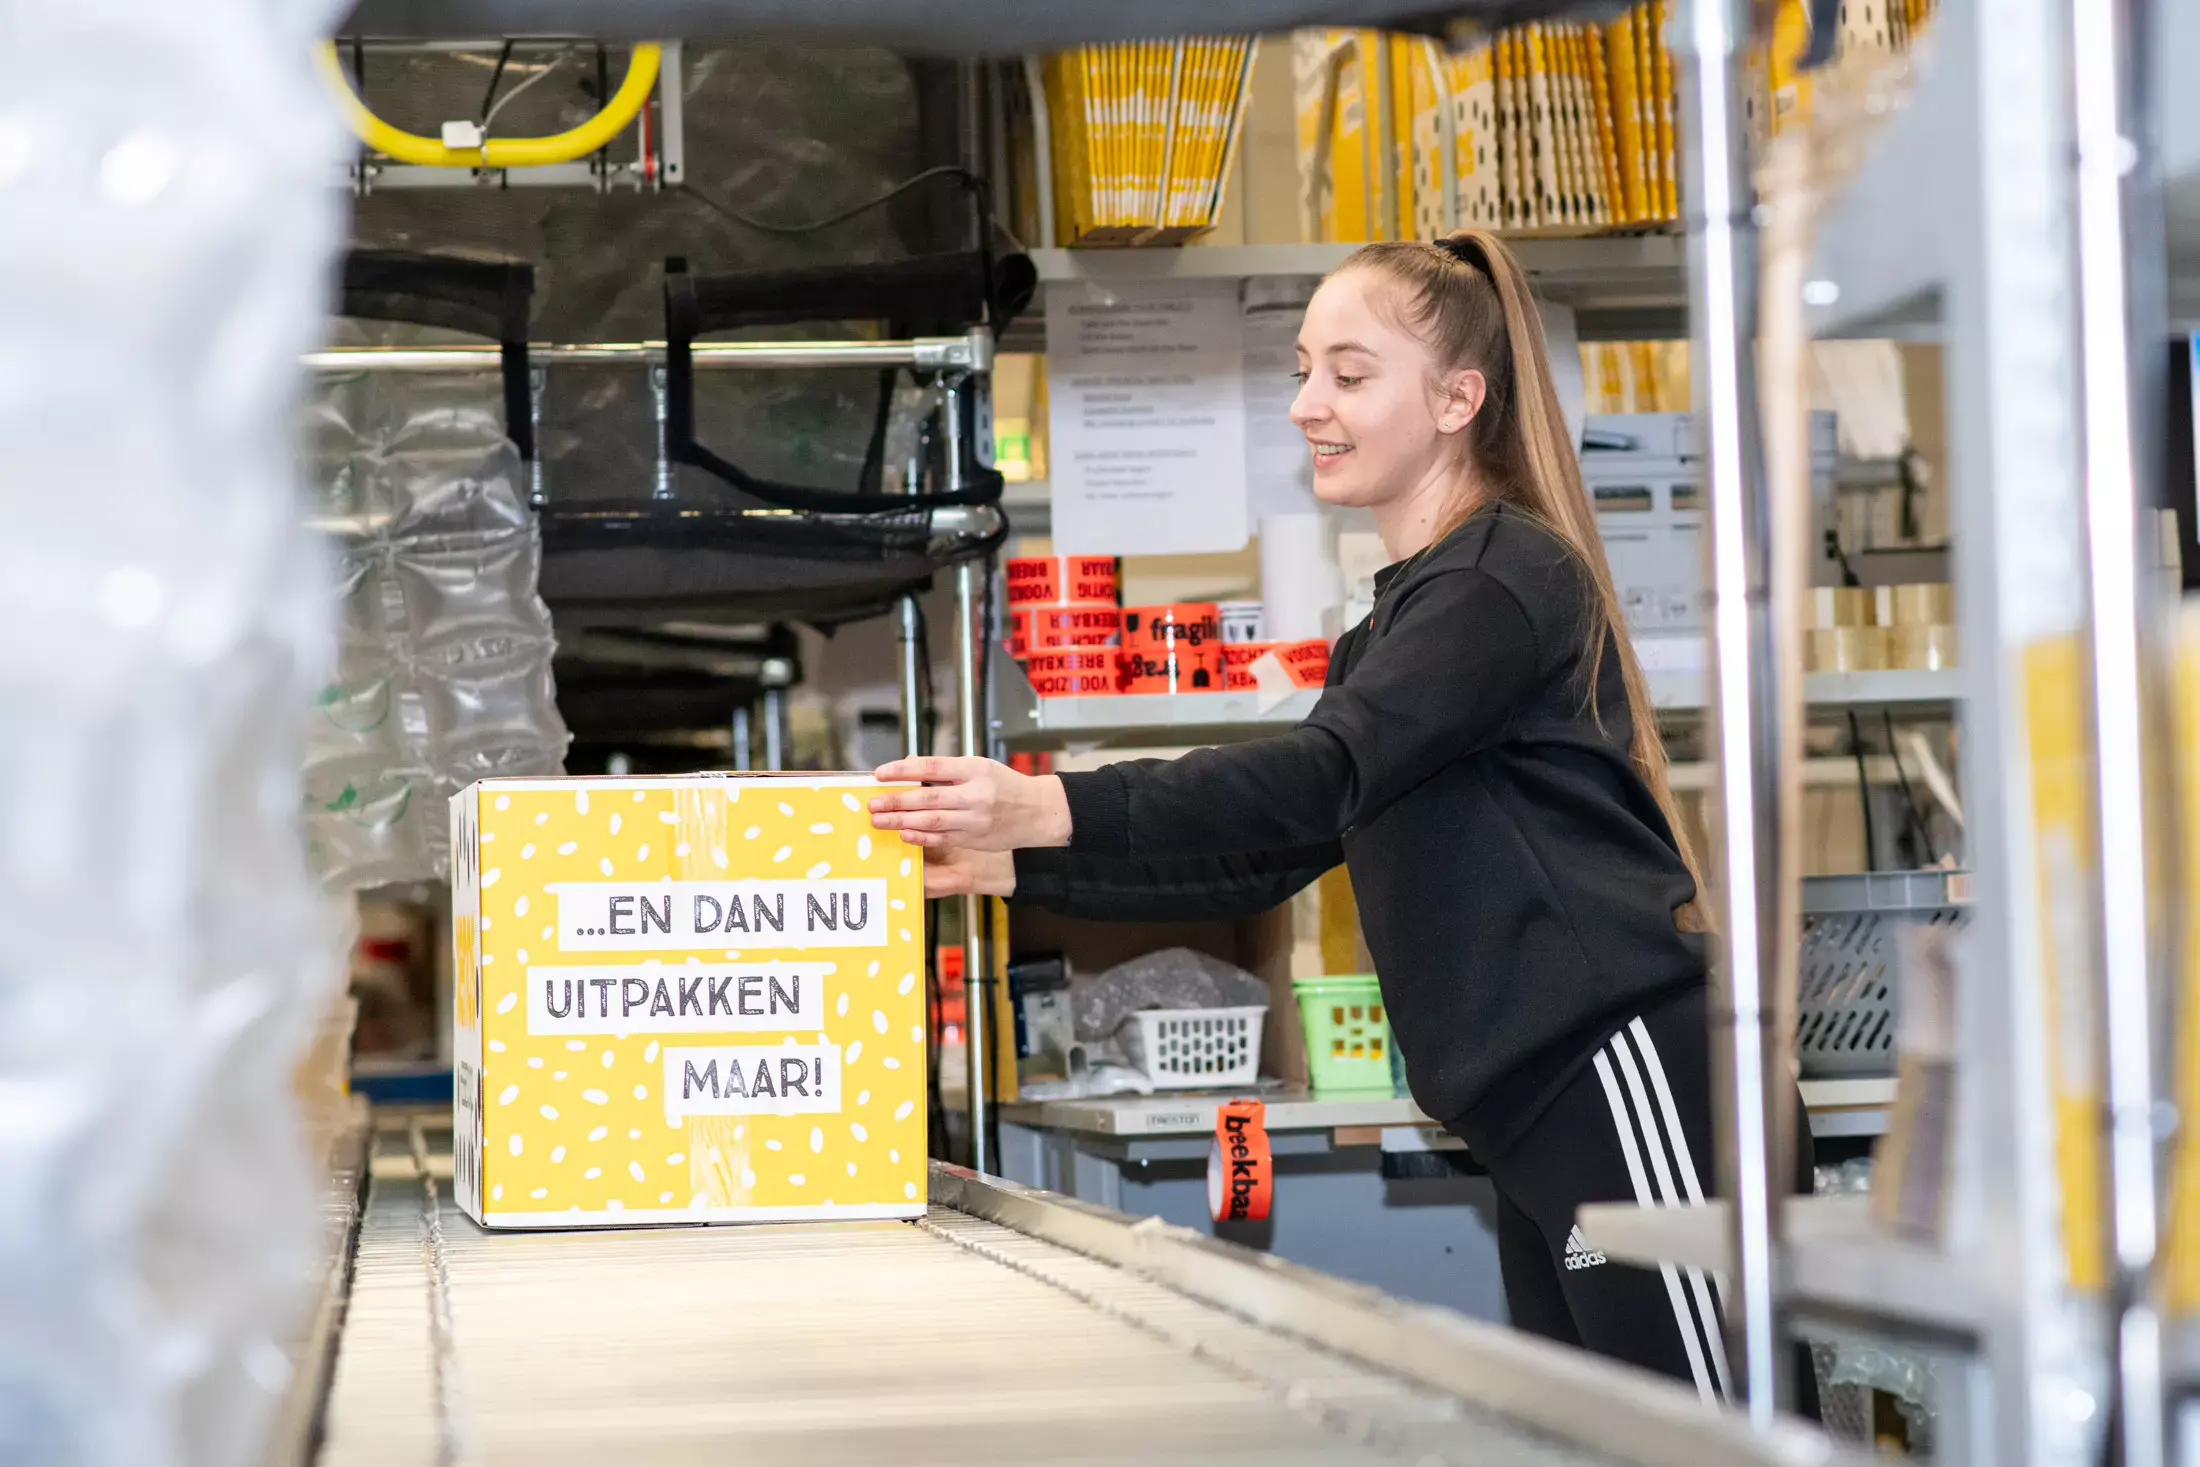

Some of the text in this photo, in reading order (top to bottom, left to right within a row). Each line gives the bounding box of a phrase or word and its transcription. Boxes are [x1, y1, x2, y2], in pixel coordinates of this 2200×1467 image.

[576, 891, 868, 937] ...EN DAN NU
[545, 975, 800, 1019] UITPAKKEN
[682, 1057, 823, 1100] MAAR!
[1564, 1250, 1607, 1271] adidas
